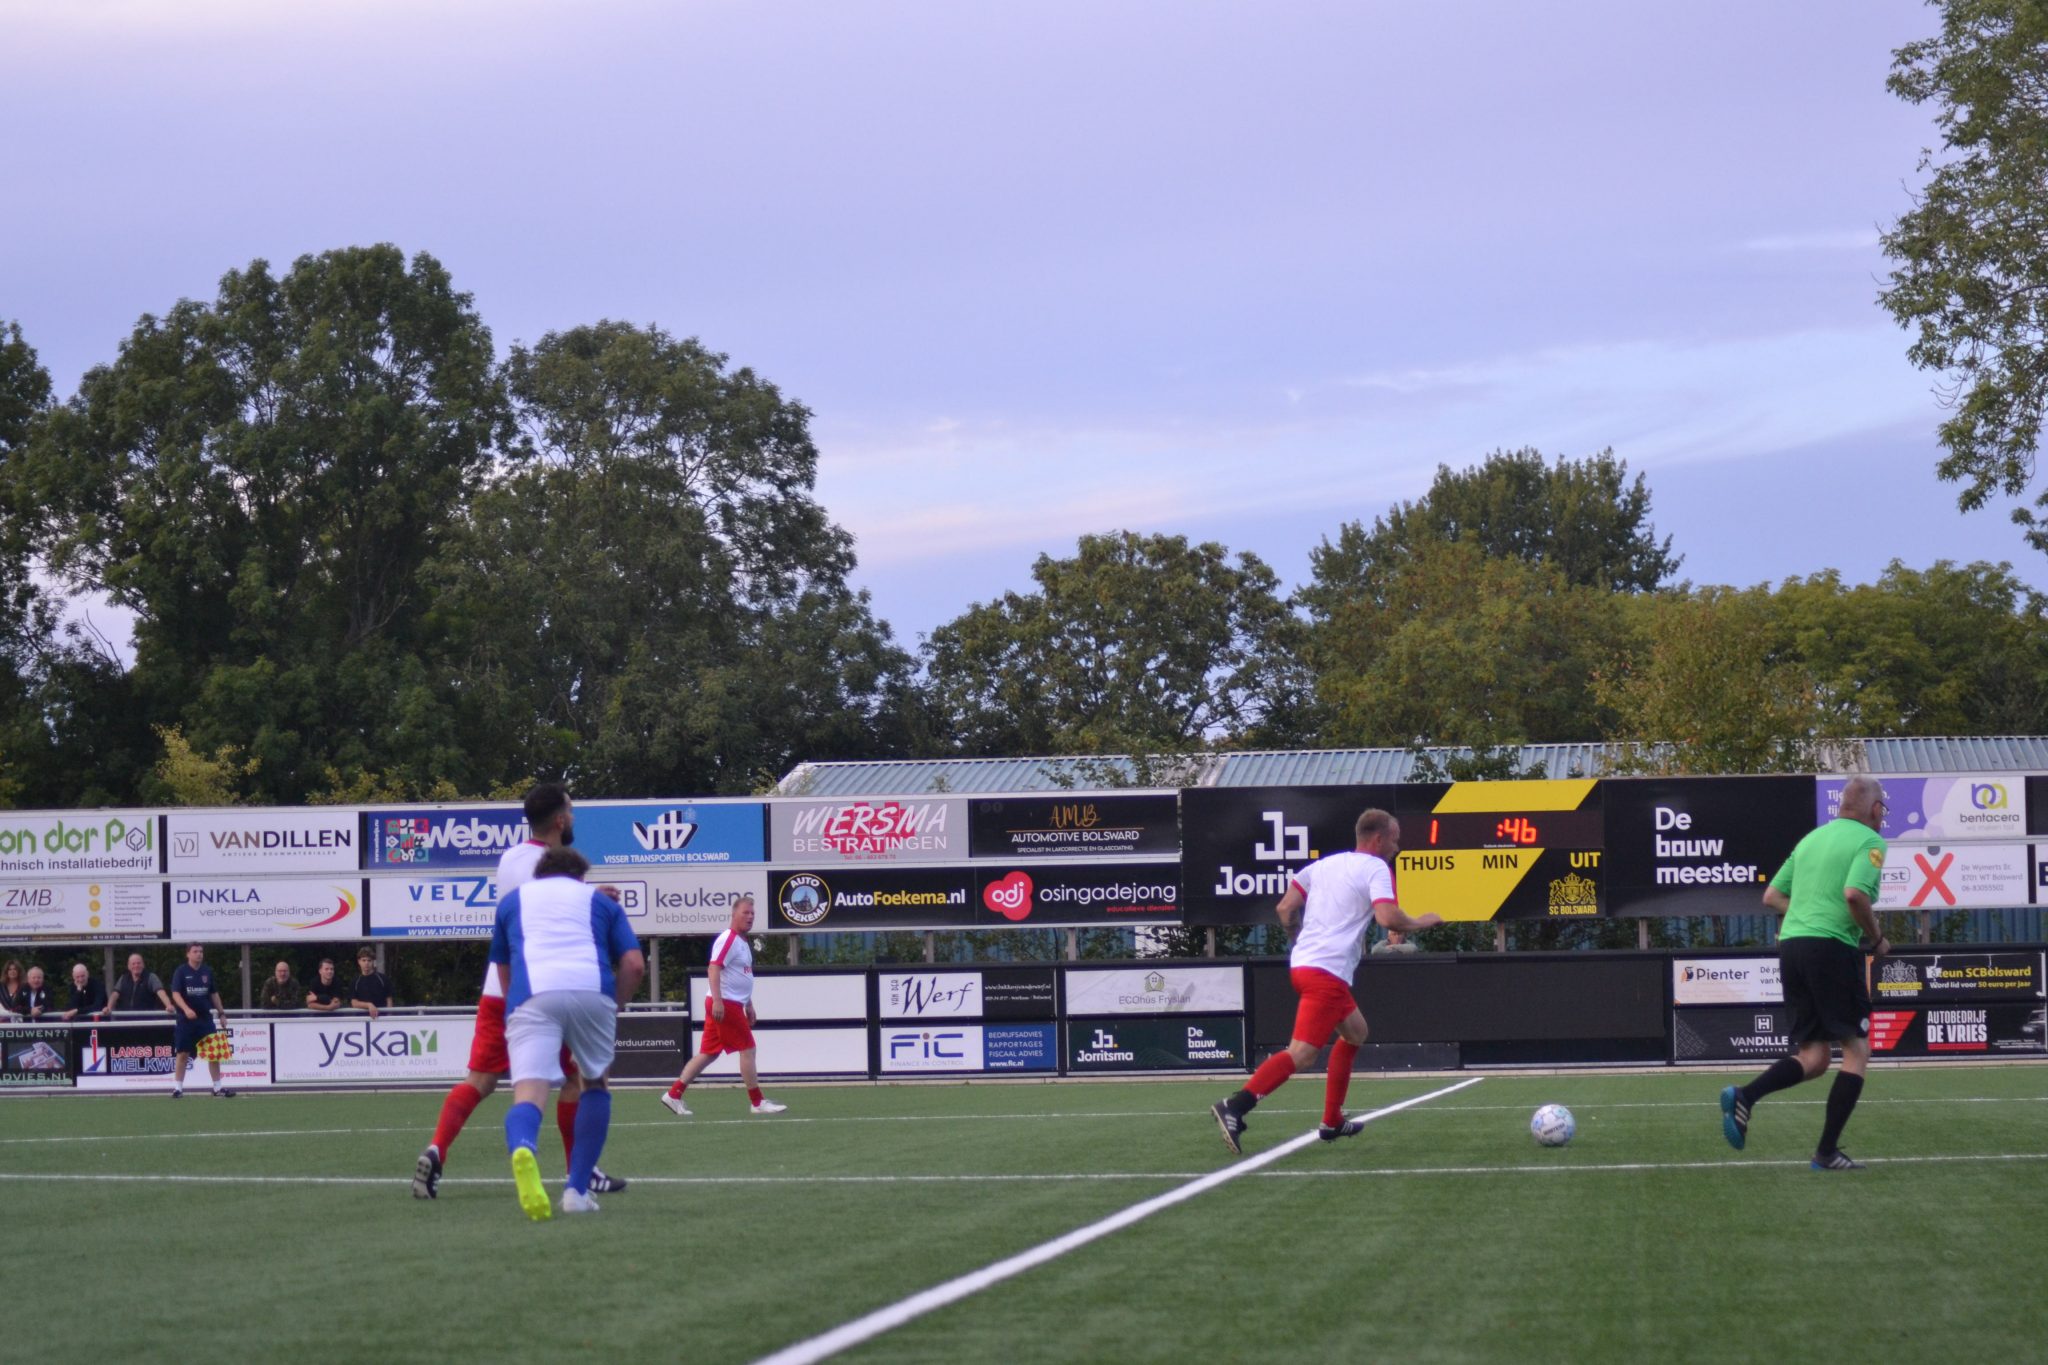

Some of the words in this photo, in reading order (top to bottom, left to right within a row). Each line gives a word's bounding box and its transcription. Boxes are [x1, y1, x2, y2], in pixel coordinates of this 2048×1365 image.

[792, 803, 948, 836] WIERSMA
[1655, 806, 1692, 831] De
[1959, 812, 2020, 824] bentacera
[209, 828, 352, 849] VANDILLEN
[428, 817, 534, 849] Webwi
[1011, 831, 1080, 843] AUTOMOTIVE
[1082, 830, 1140, 841] BOLSWARD
[1429, 819, 1439, 844] 1
[793, 836, 948, 852] BESTRATINGEN
[1017, 846, 1045, 854] SPECIALIST
[1655, 833, 1724, 857] bouw
[482, 848, 492, 857] op
[604, 854, 629, 864] VISSER
[631, 853, 686, 863] TRANSPORTEN
[686, 852, 730, 862] BOLSWARD
[1569, 851, 1601, 868] UIT
[48, 856, 153, 871] installatiebedrijf
[1399, 855, 1455, 871] THUIS
[1482, 854, 1518, 869] MIN
[790, 876, 821, 889] AUTO
[6, 888, 53, 907] ZMB
[176, 888, 262, 904] DINKLA
[834, 888, 966, 907] AutoFoekema.nl
[991, 881, 1025, 908] odj
[1039, 882, 1177, 905] osingadejong
[200, 906, 331, 917] verkeersopleidingen
[782, 900, 829, 923] FOEKEMA
[1549, 905, 1558, 915] SC
[1560, 904, 1597, 914] BOLSWARD
[1696, 967, 1750, 981] Pienter
[1965, 966, 2032, 978] SCBolsward
[902, 976, 975, 1016] Werf
[1927, 1010, 1988, 1024] AUTOBEDRIJF
[988, 1031, 1043, 1039] BEDRIJFSADVIES
[1187, 1026, 1204, 1038] De
[1927, 1024, 1944, 1043] DE
[1946, 1023, 1988, 1043] VRIES
[1188, 1038, 1217, 1048] bouw
[110, 1046, 153, 1058] LANGS
[154, 1045, 173, 1057] DE
[1018, 1049, 1043, 1057] ADVIES
[1077, 1050, 1134, 1062] Jorritsma
[335, 1058, 397, 1068] ADMINISTRATIE
[408, 1057, 438, 1067] ADVIES
[0, 1072, 68, 1082] DVIES.NL
